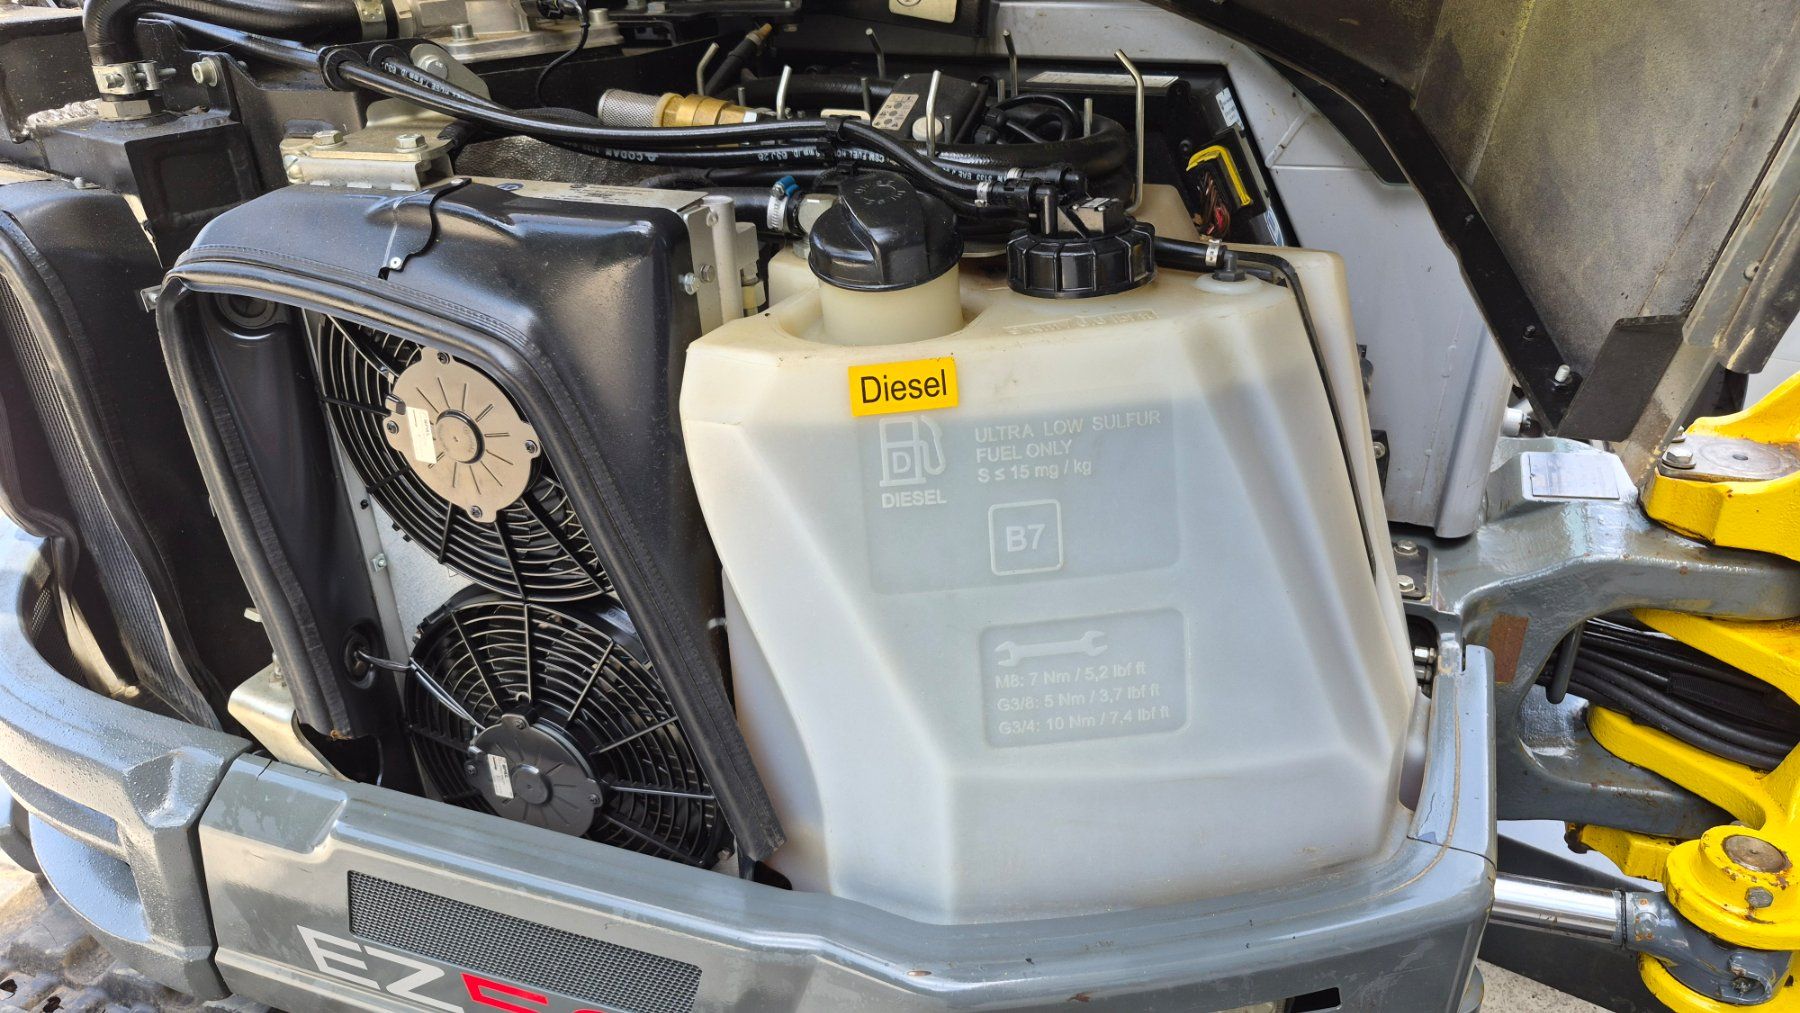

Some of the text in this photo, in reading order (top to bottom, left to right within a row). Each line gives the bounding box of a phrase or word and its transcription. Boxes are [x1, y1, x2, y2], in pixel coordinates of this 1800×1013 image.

[605, 148, 644, 162] CODAN
[849, 149, 868, 160] FUEL
[860, 369, 948, 404] Diesel
[975, 410, 1161, 443] ULTRA LOW SULFUR
[976, 439, 1073, 464] FUEL ONLY
[977, 468, 990, 484] S
[1011, 464, 1029, 480] 15
[1034, 464, 1059, 480] mg
[1063, 459, 1070, 475] /
[1073, 457, 1092, 476] kg
[881, 488, 948, 510] DIESEL
[1005, 523, 1045, 553] B7
[995, 661, 1146, 689] M8: 7 Nm / 5,2 lbf ft
[997, 696, 1040, 712] G3/8:
[1044, 694, 1055, 708] 5
[1058, 693, 1085, 707] Nm
[1100, 688, 1122, 704] 3,7
[1127, 685, 1147, 700] lbf
[1150, 683, 1160, 697] ft
[998, 720, 1040, 735] G3/4:
[1046, 716, 1065, 731] 10
[1069, 715, 1096, 729] Nm
[1137, 707, 1156, 721] lbf
[1159, 705, 1170, 719] ft
